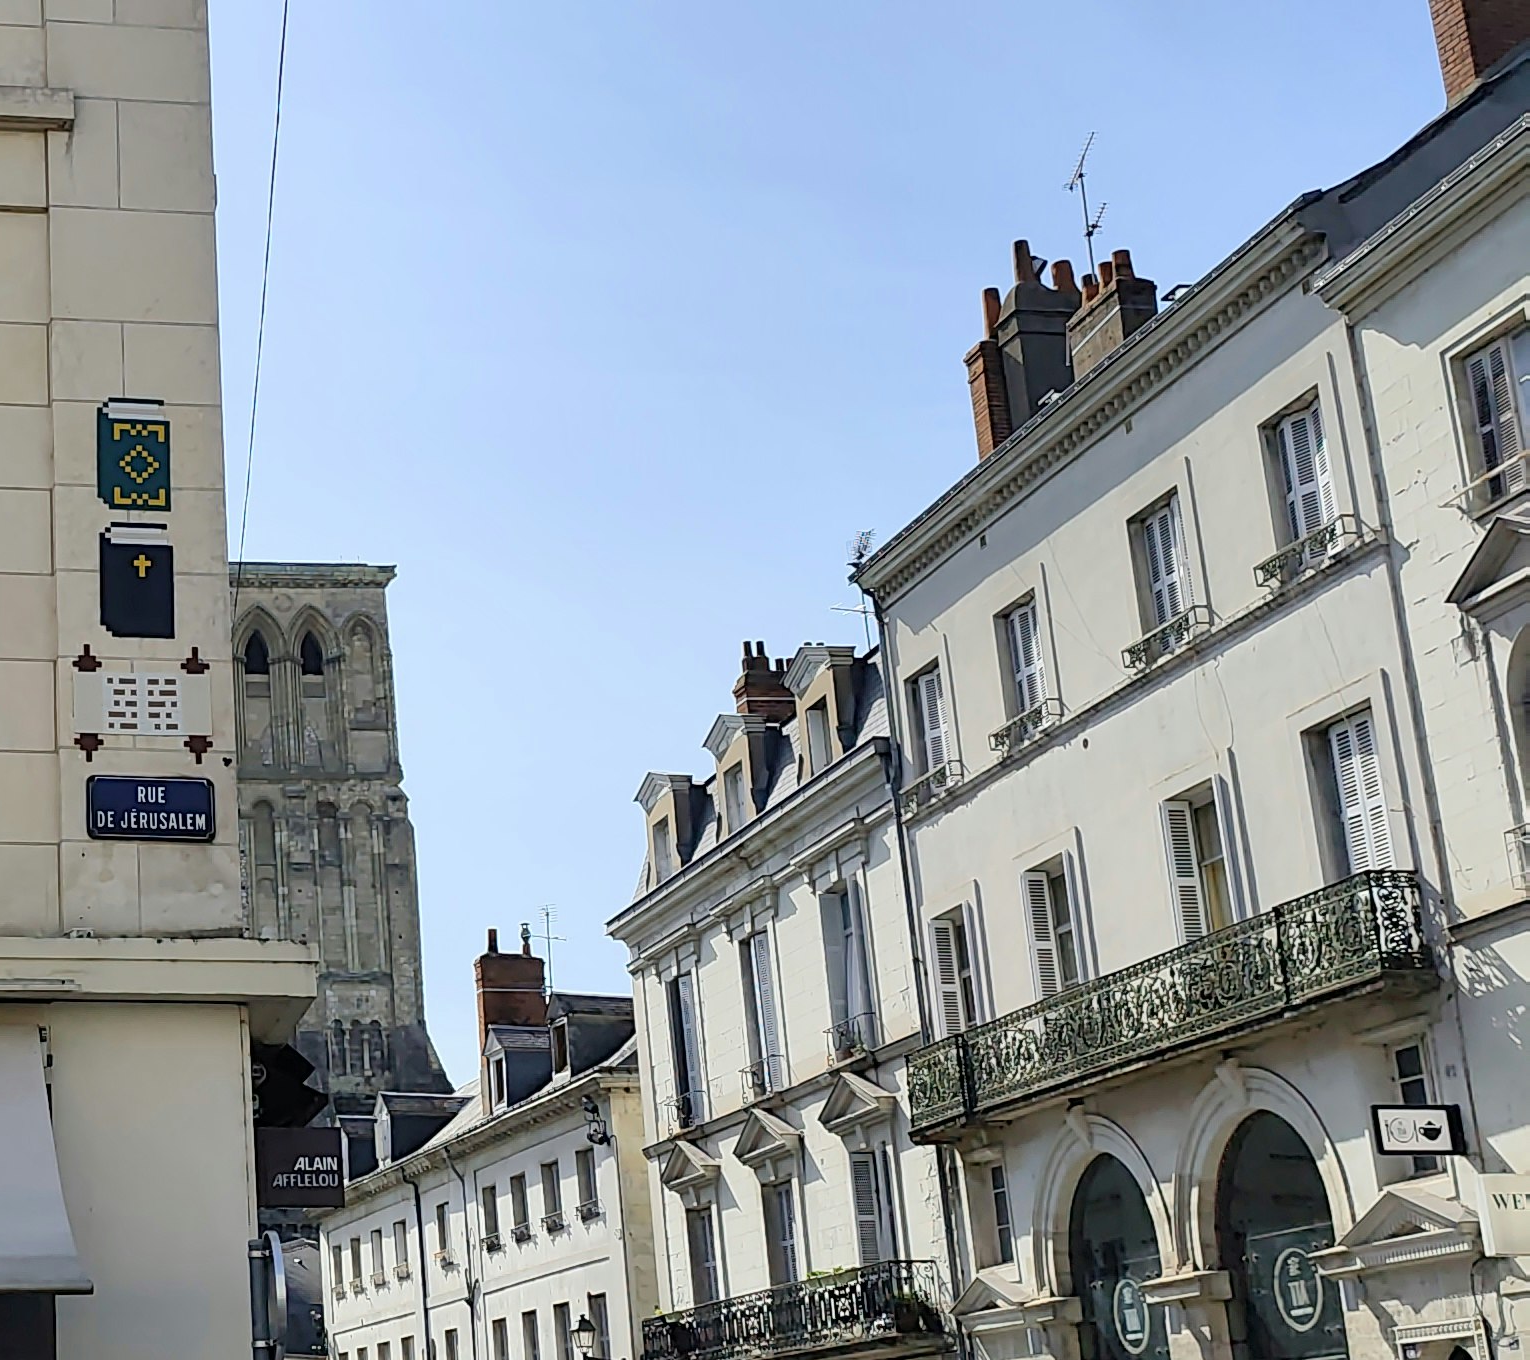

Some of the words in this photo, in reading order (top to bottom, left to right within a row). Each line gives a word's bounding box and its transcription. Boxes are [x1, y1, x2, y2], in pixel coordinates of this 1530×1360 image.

[137, 786, 166, 803] RUE
[97, 810, 115, 828] DE
[120, 808, 207, 830] JÉRUSALEM
[293, 1156, 338, 1171] ALAIN
[272, 1173, 339, 1188] AFFLELOU
